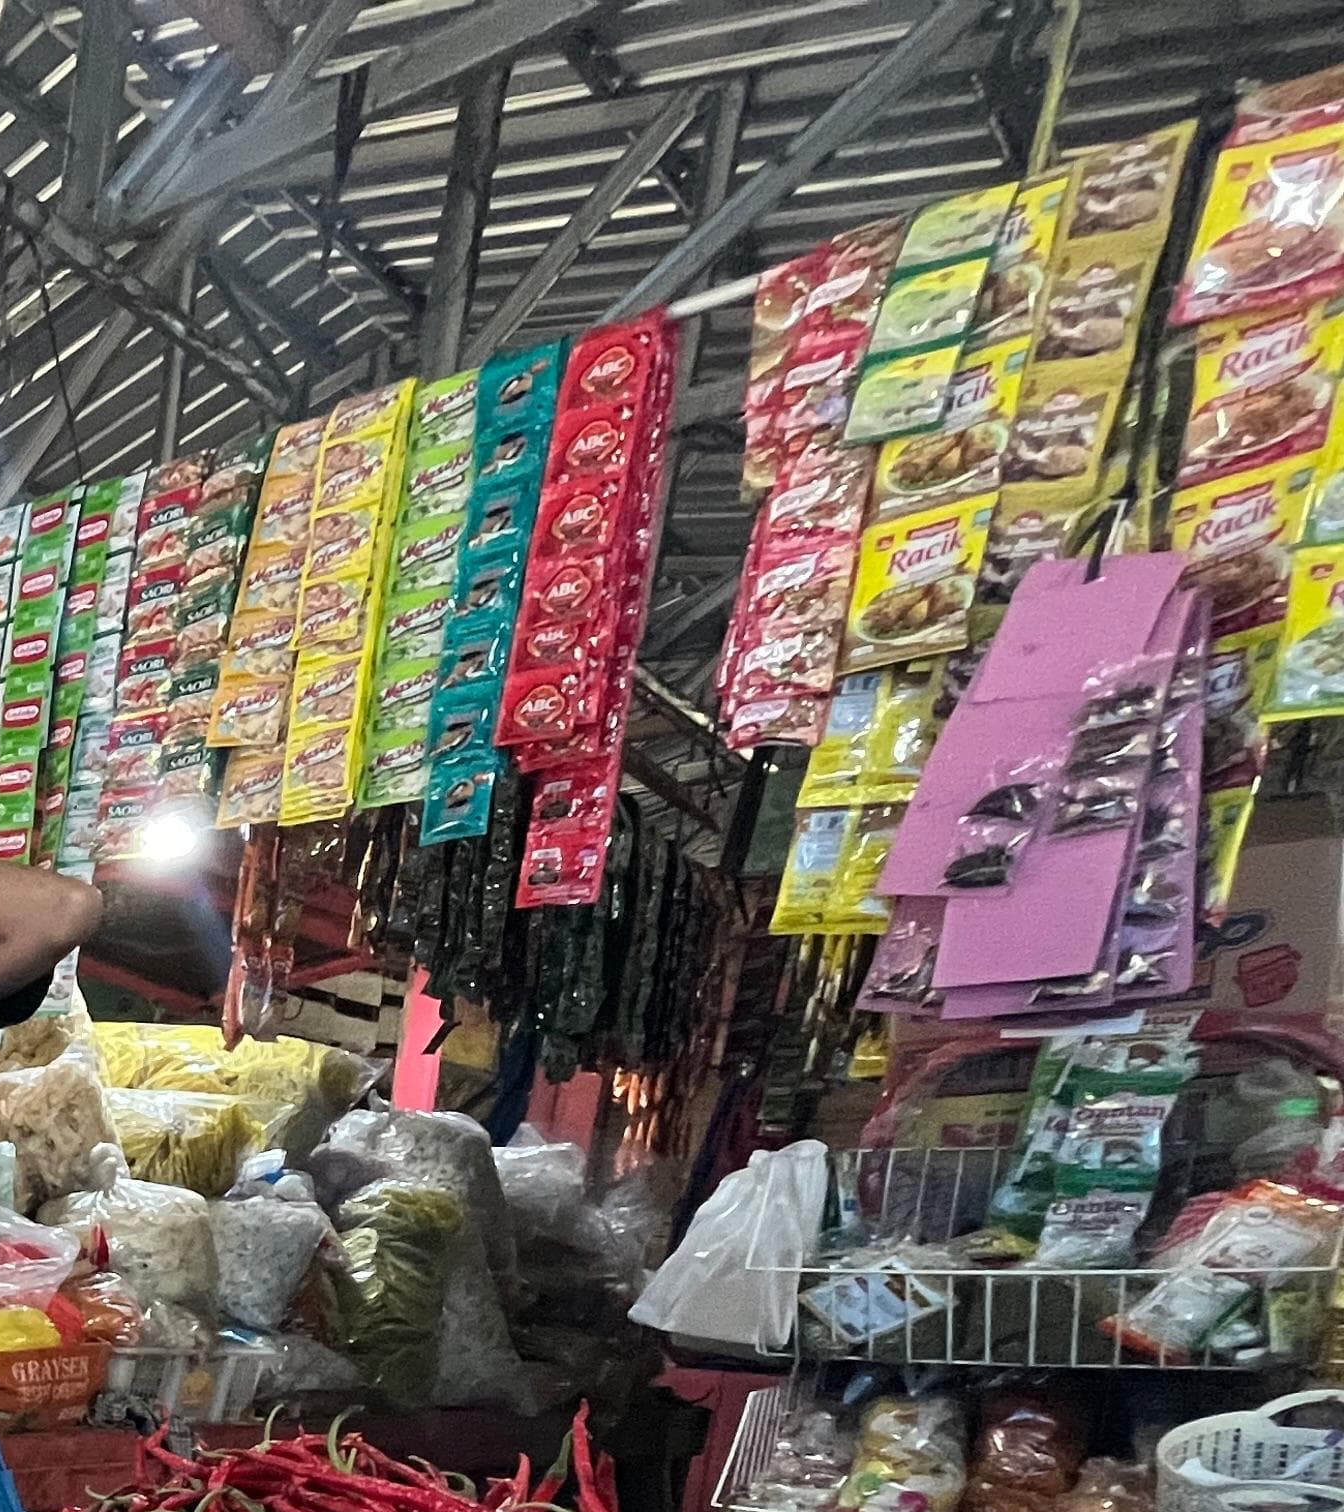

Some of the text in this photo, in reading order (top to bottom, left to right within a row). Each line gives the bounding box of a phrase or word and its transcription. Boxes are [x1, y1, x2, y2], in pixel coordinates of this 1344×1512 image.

[587, 361, 625, 379] ABC
[573, 432, 611, 451] ABC
[560, 507, 596, 526] ABC
[1190, 496, 1276, 550] Racik
[887, 531, 962, 576] Racik
[142, 583, 174, 599] SAORI
[546, 581, 584, 599] ABC
[130, 658, 165, 674] SAORI
[520, 699, 557, 713] ABC
